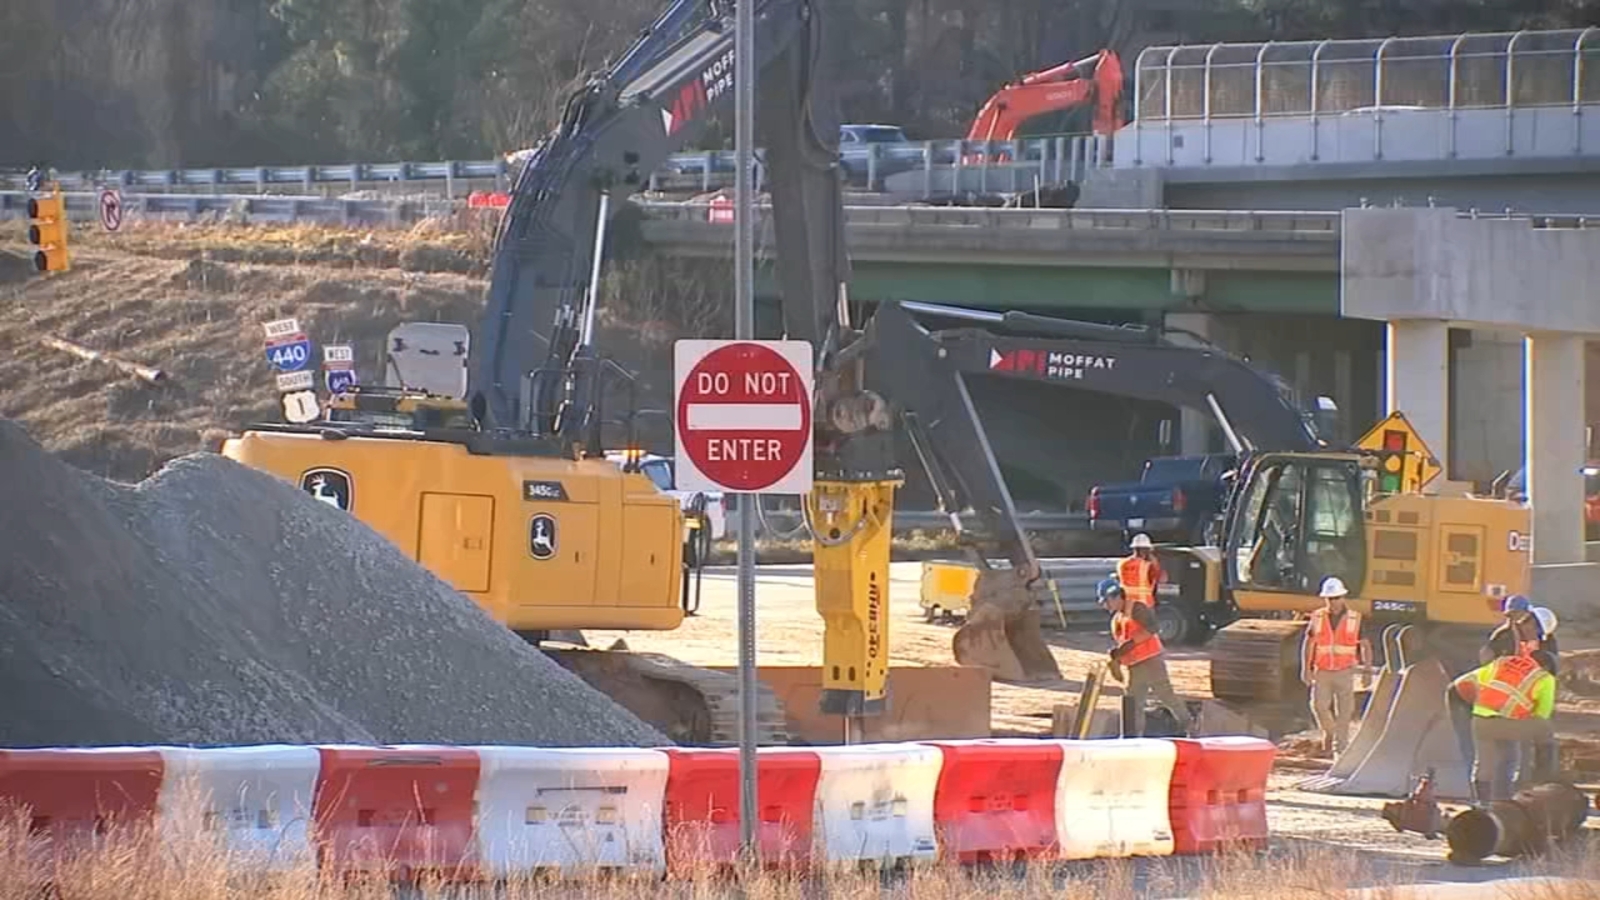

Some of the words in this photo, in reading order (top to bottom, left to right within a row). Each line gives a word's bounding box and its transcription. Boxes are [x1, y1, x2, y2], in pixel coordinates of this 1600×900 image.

[703, 49, 735, 87] MOFF
[706, 72, 735, 103] PIPE
[268, 321, 295, 335] WEST
[273, 345, 306, 364] 440
[1048, 352, 1116, 369] MOFFAT
[1047, 366, 1084, 379] PIPE
[697, 372, 730, 395] DO
[744, 372, 791, 395] NOT
[297, 398, 306, 416] 1
[707, 438, 782, 461] ENTER
